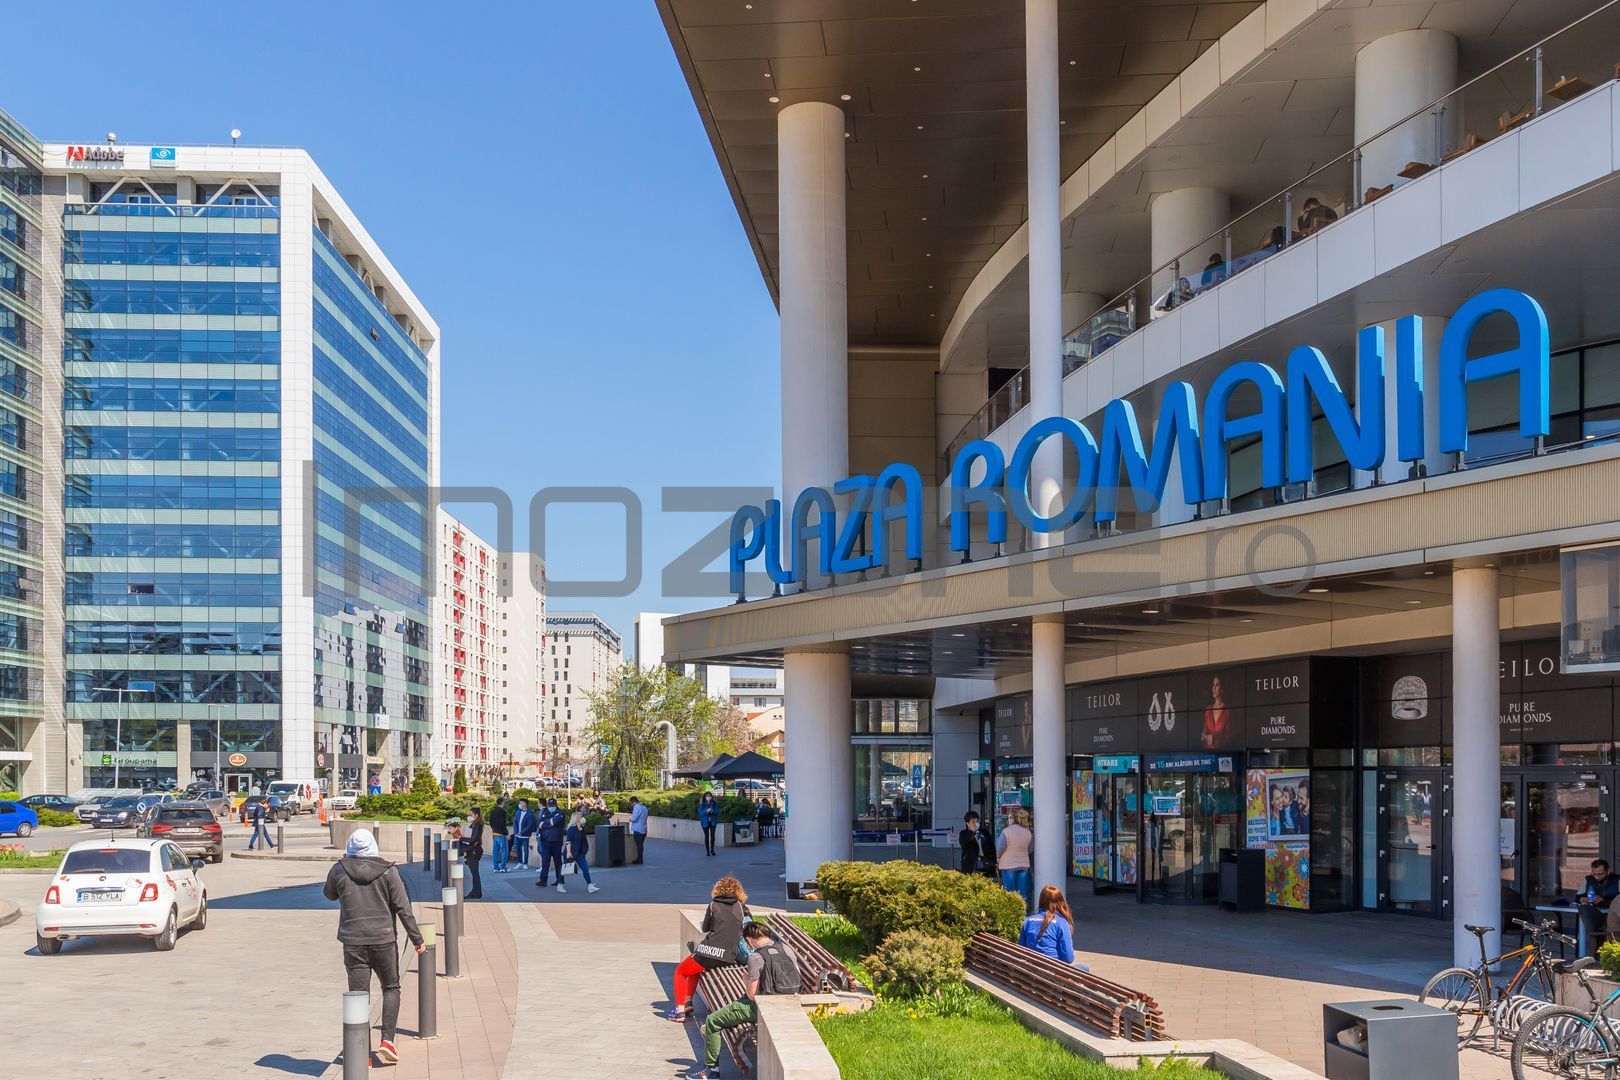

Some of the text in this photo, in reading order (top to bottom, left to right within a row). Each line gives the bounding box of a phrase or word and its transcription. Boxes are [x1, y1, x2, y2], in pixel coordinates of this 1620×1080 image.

[85, 147, 125, 161] Adobe
[730, 288, 1550, 594] PLAZA ROMANIA
[1500, 657, 1554, 679] EILO
[1255, 675, 1300, 691] TEILOR
[1087, 692, 1121, 708] TEILOR
[1509, 702, 1536, 713] PURE
[1270, 716, 1287, 725] PURE
[1261, 725, 1296, 735] DIAMONDS
[1157, 760, 1165, 768] 15
[91, 892, 102, 900] 512
[105, 892, 120, 900] YLA
